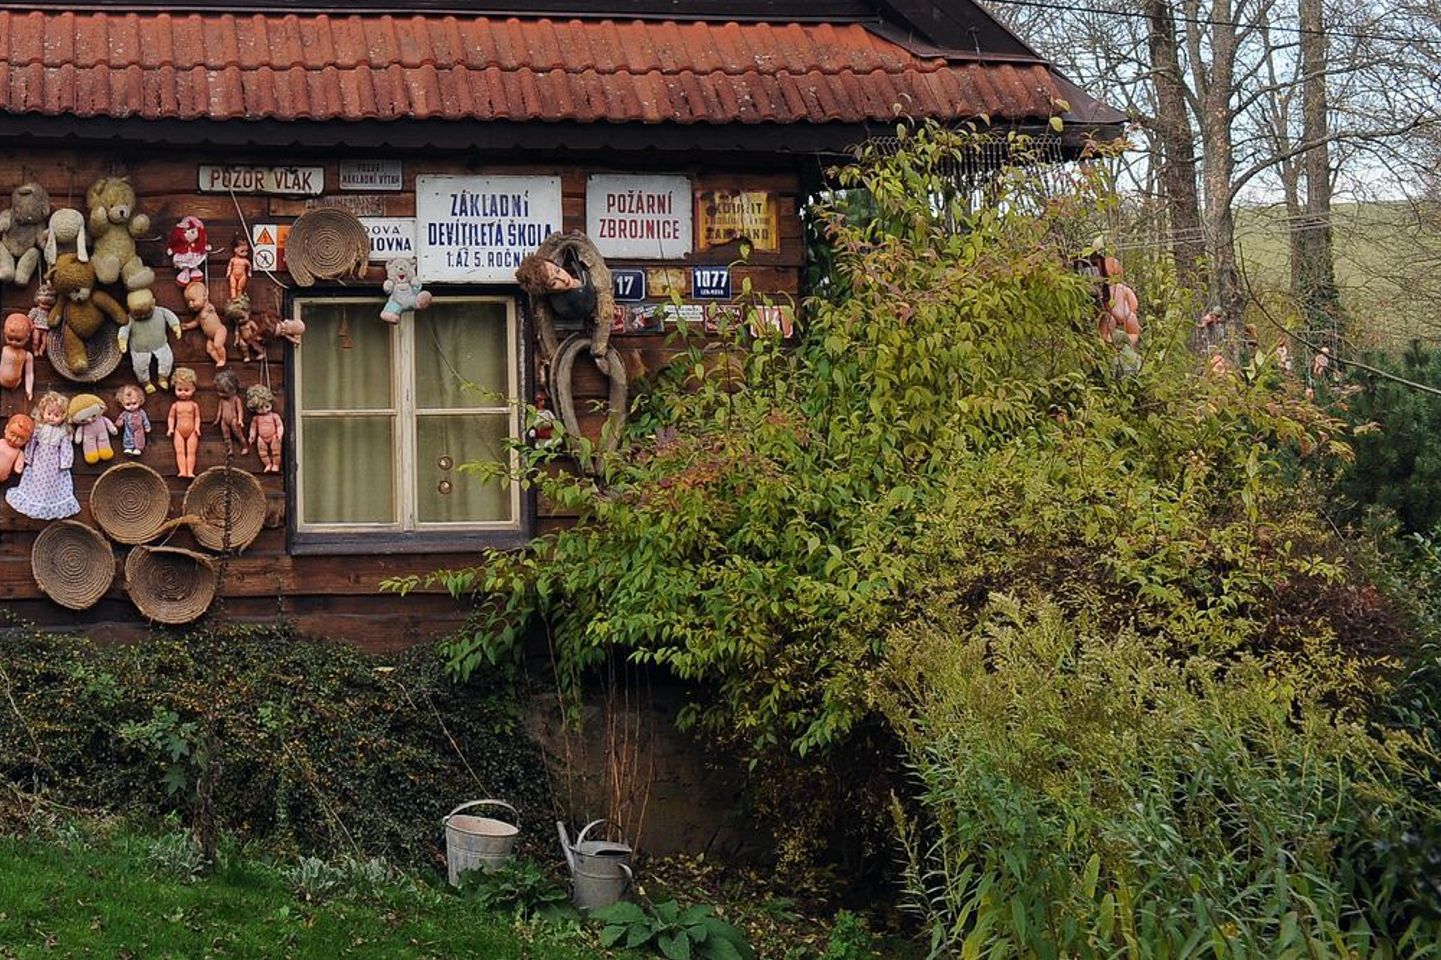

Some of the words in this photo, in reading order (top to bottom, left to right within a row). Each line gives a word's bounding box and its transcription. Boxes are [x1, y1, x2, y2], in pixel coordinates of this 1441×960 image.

[210, 168, 265, 189] POZOR
[274, 171, 312, 191] VLAK
[450, 189, 528, 217] ZÁKLADNÍ
[606, 190, 672, 214] POŽÁRNÍ
[428, 218, 504, 246] DEVÍTILETÁ
[599, 219, 680, 239] ZBROJNICE
[475, 252, 484, 267] 5.
[616, 276, 634, 295] 17
[695, 270, 727, 288] 1077
